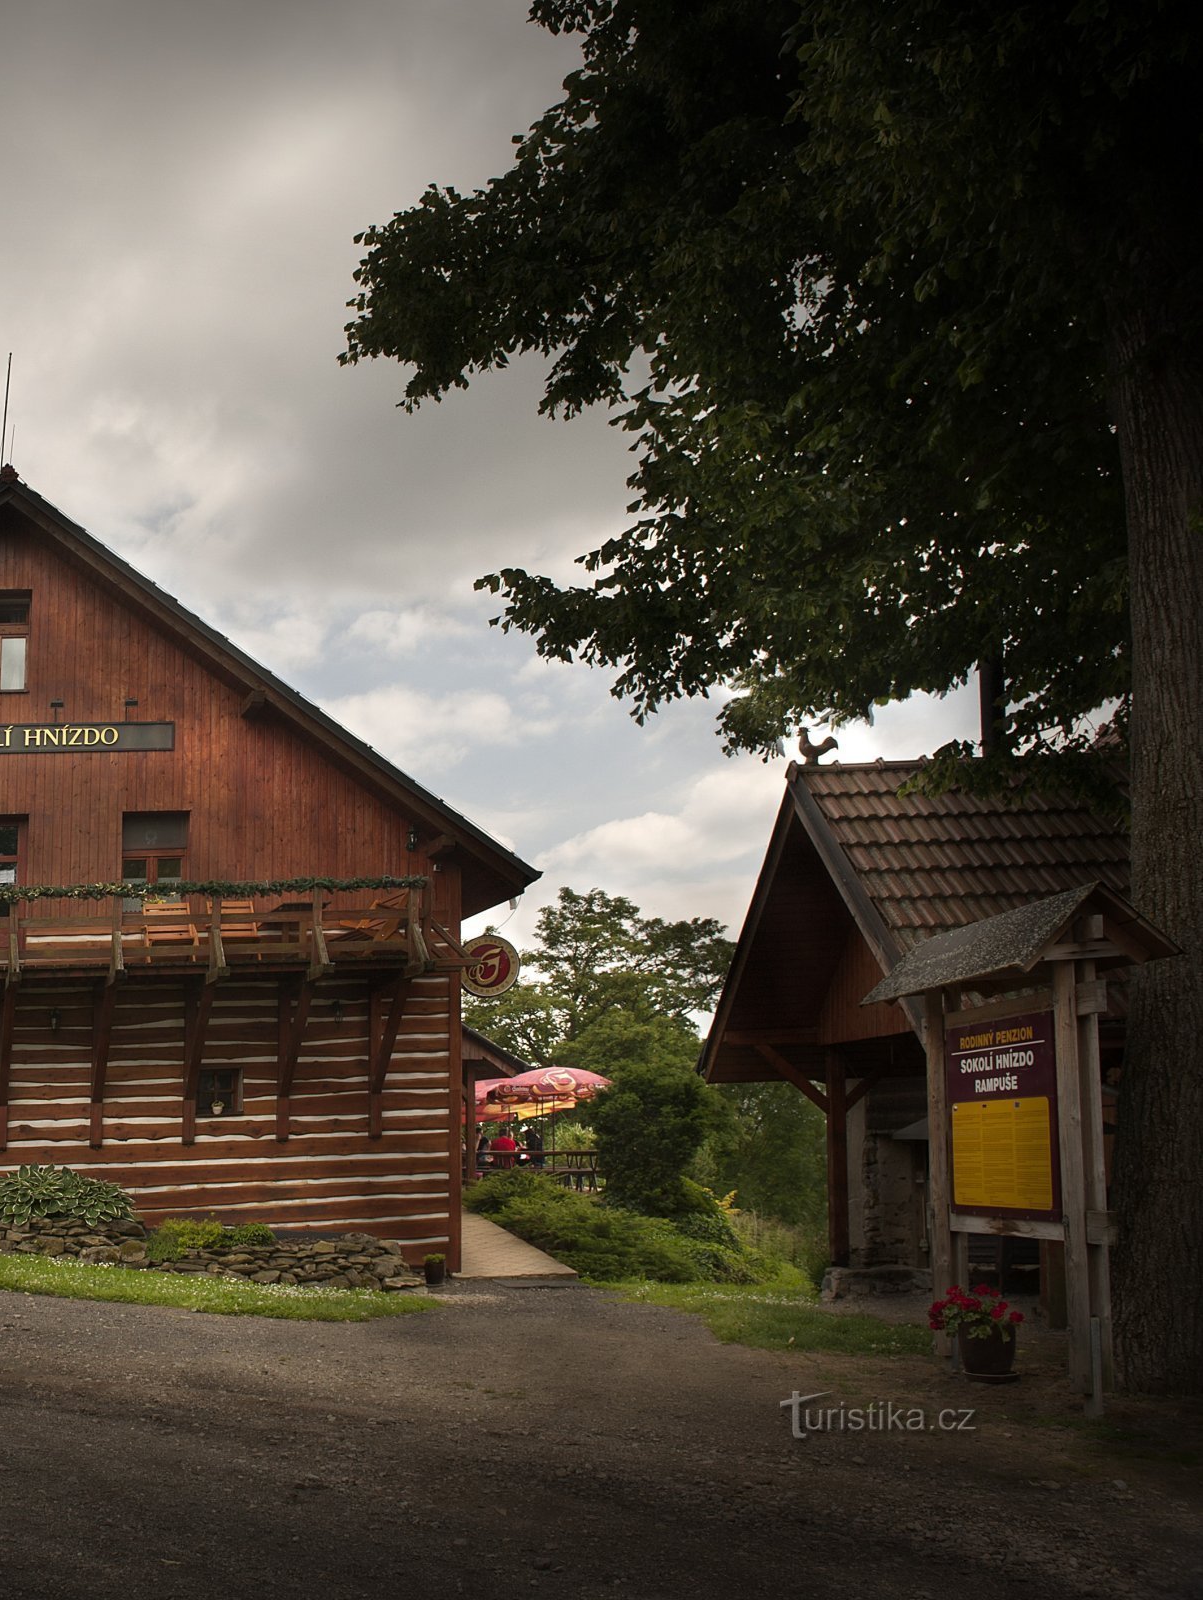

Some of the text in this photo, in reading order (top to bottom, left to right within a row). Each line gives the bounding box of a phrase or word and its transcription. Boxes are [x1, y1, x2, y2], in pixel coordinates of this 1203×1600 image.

[24, 724, 119, 748] HNÍZDO
[959, 1026, 1033, 1050] RODINNÝ PENZION
[960, 1048, 1034, 1074] SOKOLÍ HNÍZDO
[974, 1071, 1019, 1094] RAMPUŠE
